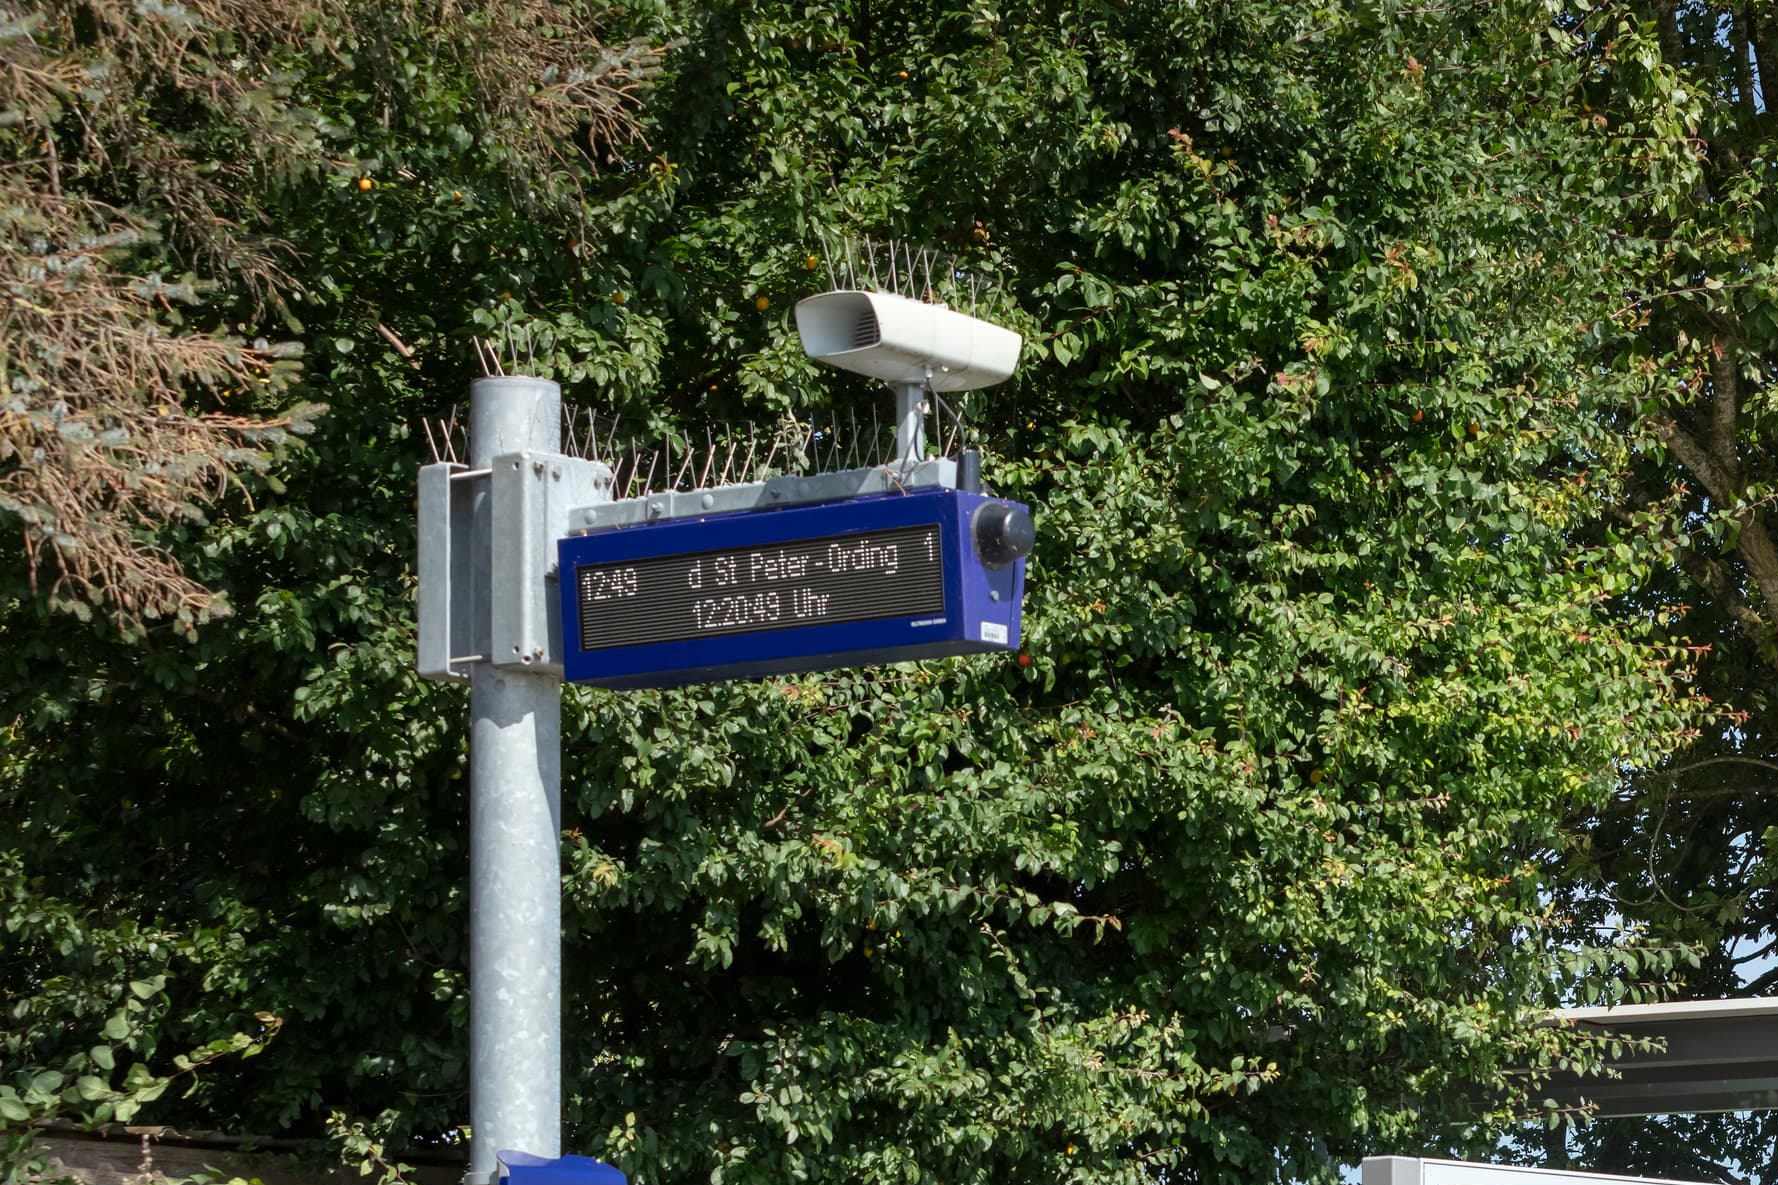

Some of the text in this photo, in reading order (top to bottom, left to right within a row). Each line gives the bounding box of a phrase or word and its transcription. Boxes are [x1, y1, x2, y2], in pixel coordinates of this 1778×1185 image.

[582, 567, 638, 601] 12:49
[714, 556, 738, 585] St
[750, 540, 898, 582] Peter-Ording
[923, 532, 934, 561] 1
[692, 588, 830, 628] 12:20:49 Uhr
